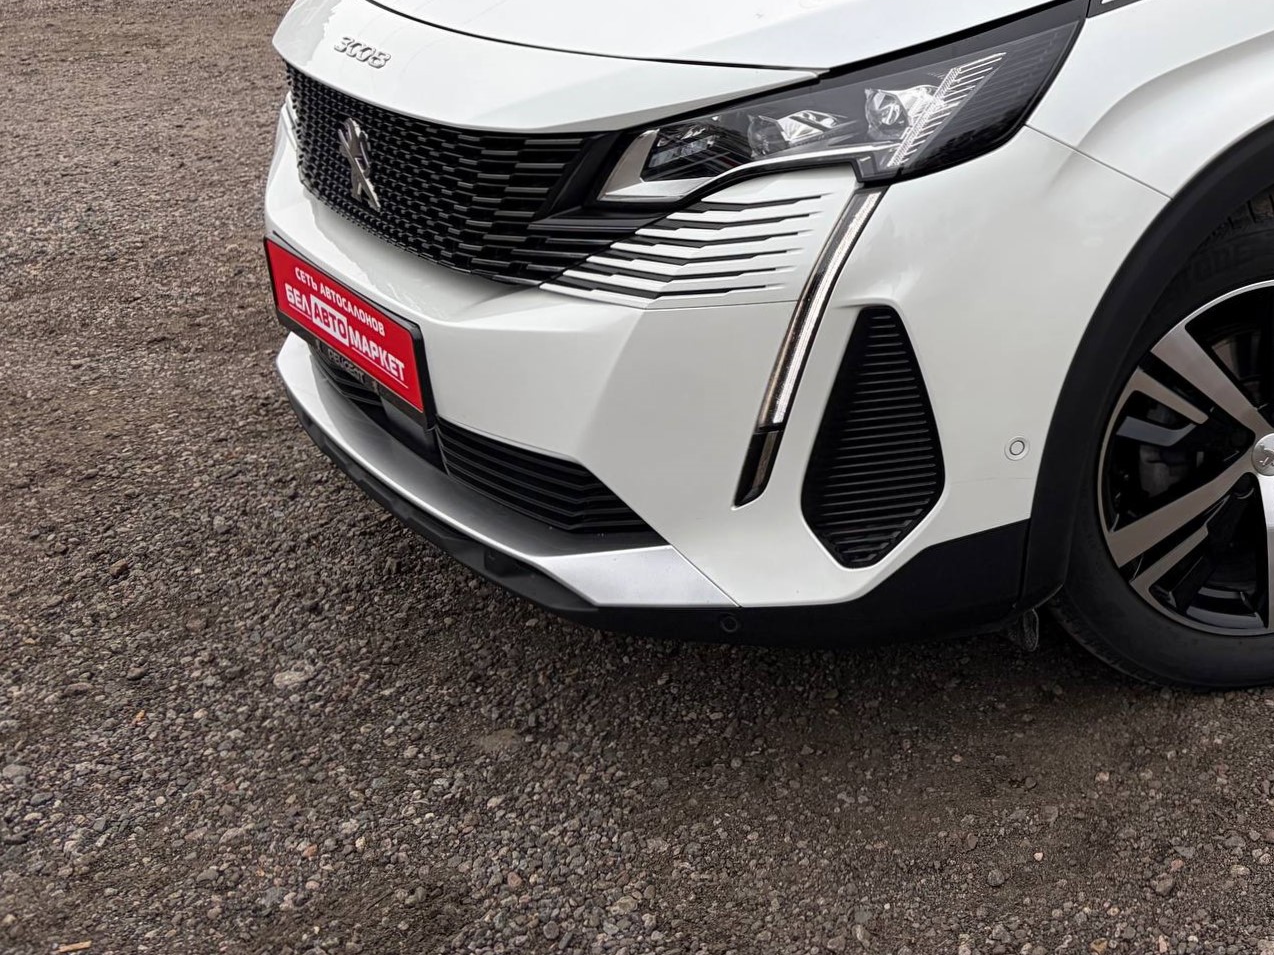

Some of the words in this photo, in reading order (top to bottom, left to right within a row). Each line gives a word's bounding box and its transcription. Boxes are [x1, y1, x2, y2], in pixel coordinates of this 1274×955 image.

[333, 36, 392, 69] 3008
[285, 283, 312, 317] БЕЛ
[312, 300, 348, 343] АВТО
[348, 325, 405, 382] МАРКЕТ
[294, 266, 318, 292] СЕТЬ
[320, 282, 386, 337] АВТОСАЛОНОВ
